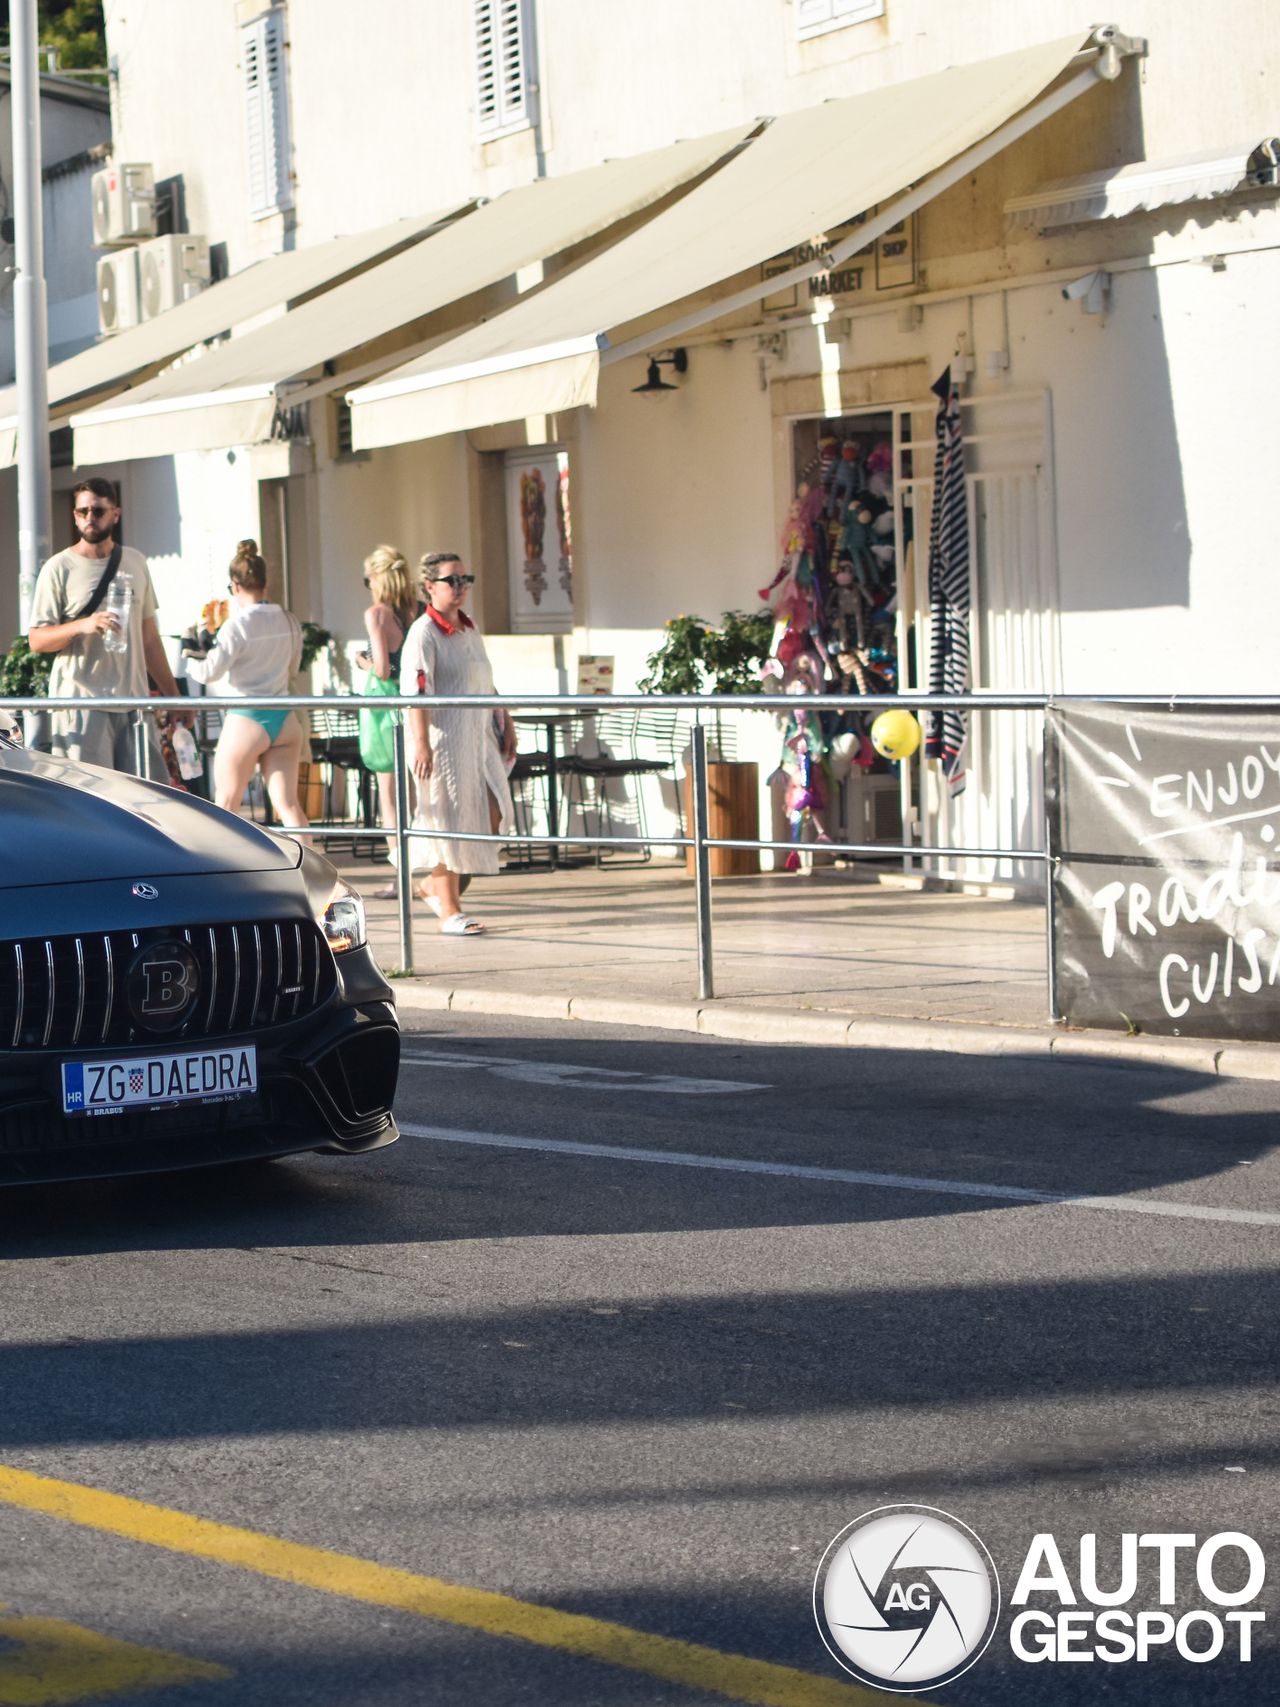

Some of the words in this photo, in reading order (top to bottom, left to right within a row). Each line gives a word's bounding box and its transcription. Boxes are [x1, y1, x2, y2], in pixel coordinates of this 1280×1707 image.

[882, 240, 908, 258] SHOP
[809, 267, 863, 298] MARKET
[141, 960, 190, 1014] B
[87, 1064, 125, 1104] ZG
[147, 1051, 253, 1098] DAEDRA
[67, 1091, 83, 1104] HR
[93, 1107, 124, 1116] BRABUS
